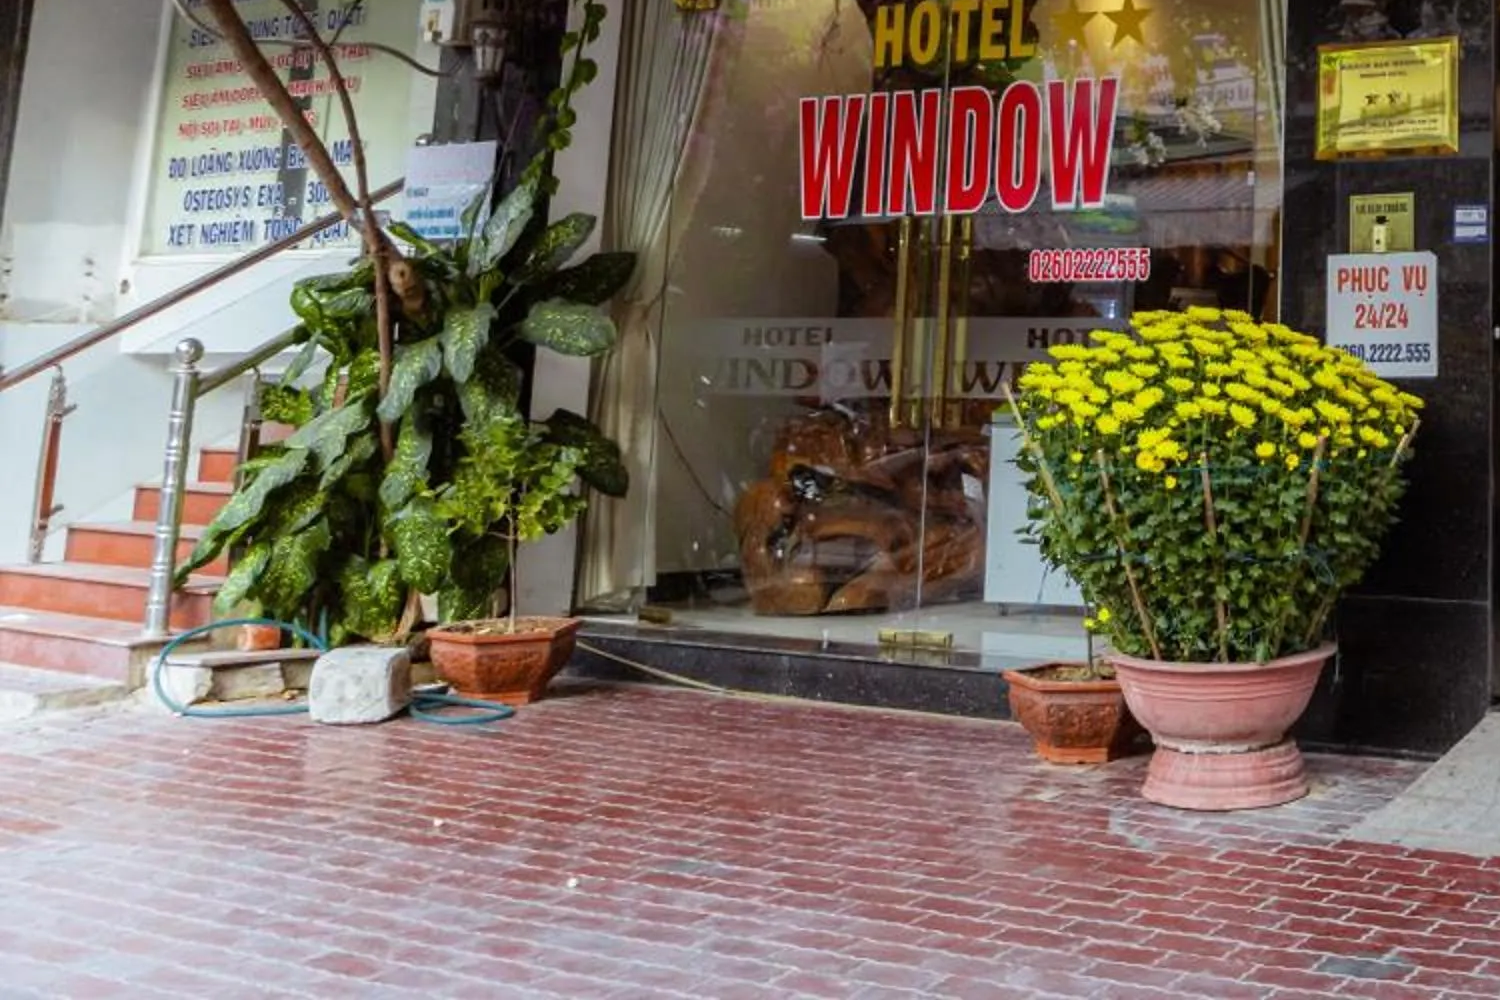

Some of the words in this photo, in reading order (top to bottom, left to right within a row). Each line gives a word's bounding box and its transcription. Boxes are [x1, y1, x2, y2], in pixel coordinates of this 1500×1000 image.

[800, 77, 1121, 220] WINDOW
[1029, 248, 1150, 282] 02602222555
[1337, 266, 1389, 299] PHỤC
[1402, 265, 1428, 297] VỤ
[1355, 303, 1408, 329] 24/24
